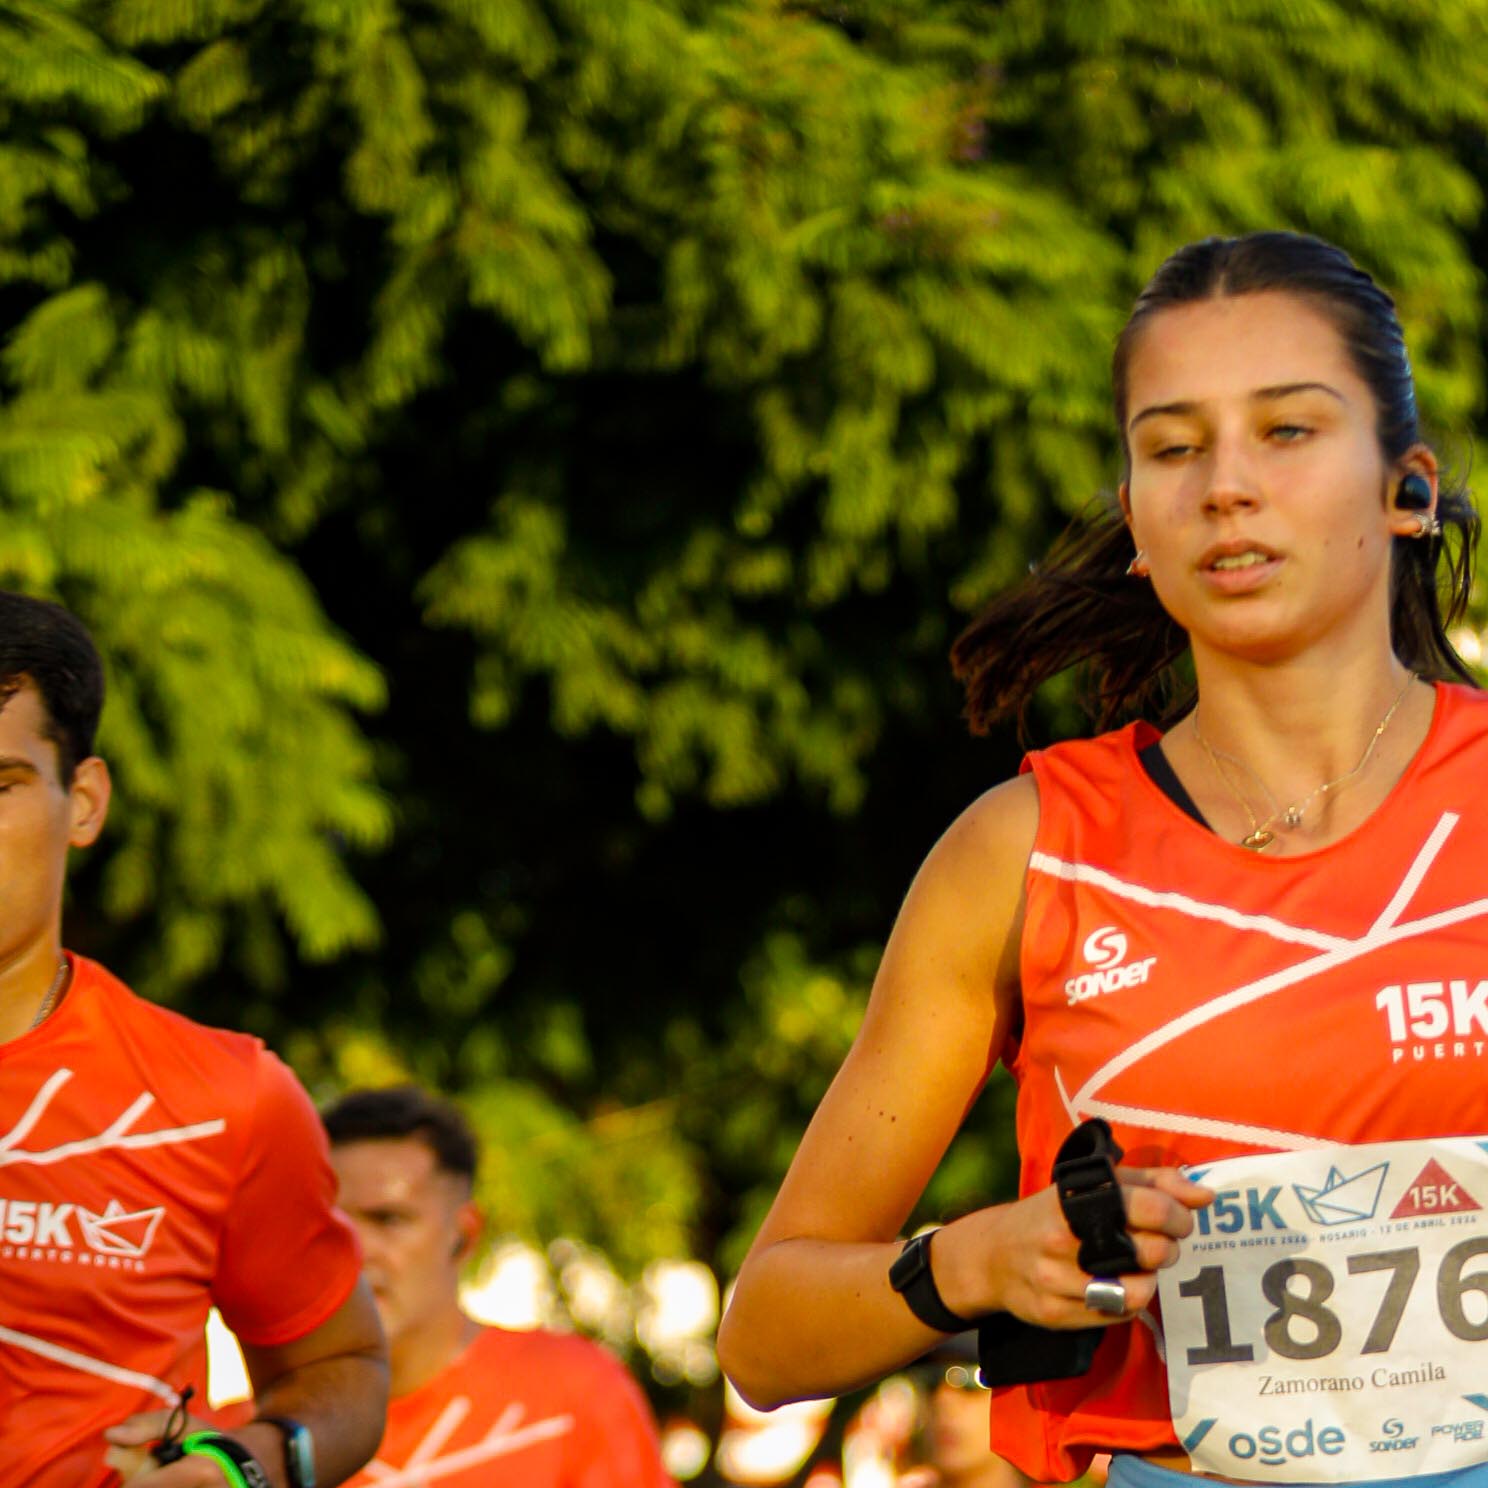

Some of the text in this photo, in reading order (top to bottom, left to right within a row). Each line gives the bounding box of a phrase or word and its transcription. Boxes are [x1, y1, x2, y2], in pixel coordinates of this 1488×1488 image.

[1409, 1184, 1460, 1209] 15K
[1192, 1239, 1236, 1252] PUERTO
[1240, 1236, 1276, 1247] NORTE
[1319, 1229, 1367, 1243] ROSARIO
[1413, 1218, 1445, 1229] ABRIL
[1258, 1362, 1446, 1396] Zamorano Camila
[1229, 1418, 1346, 1465] osde
